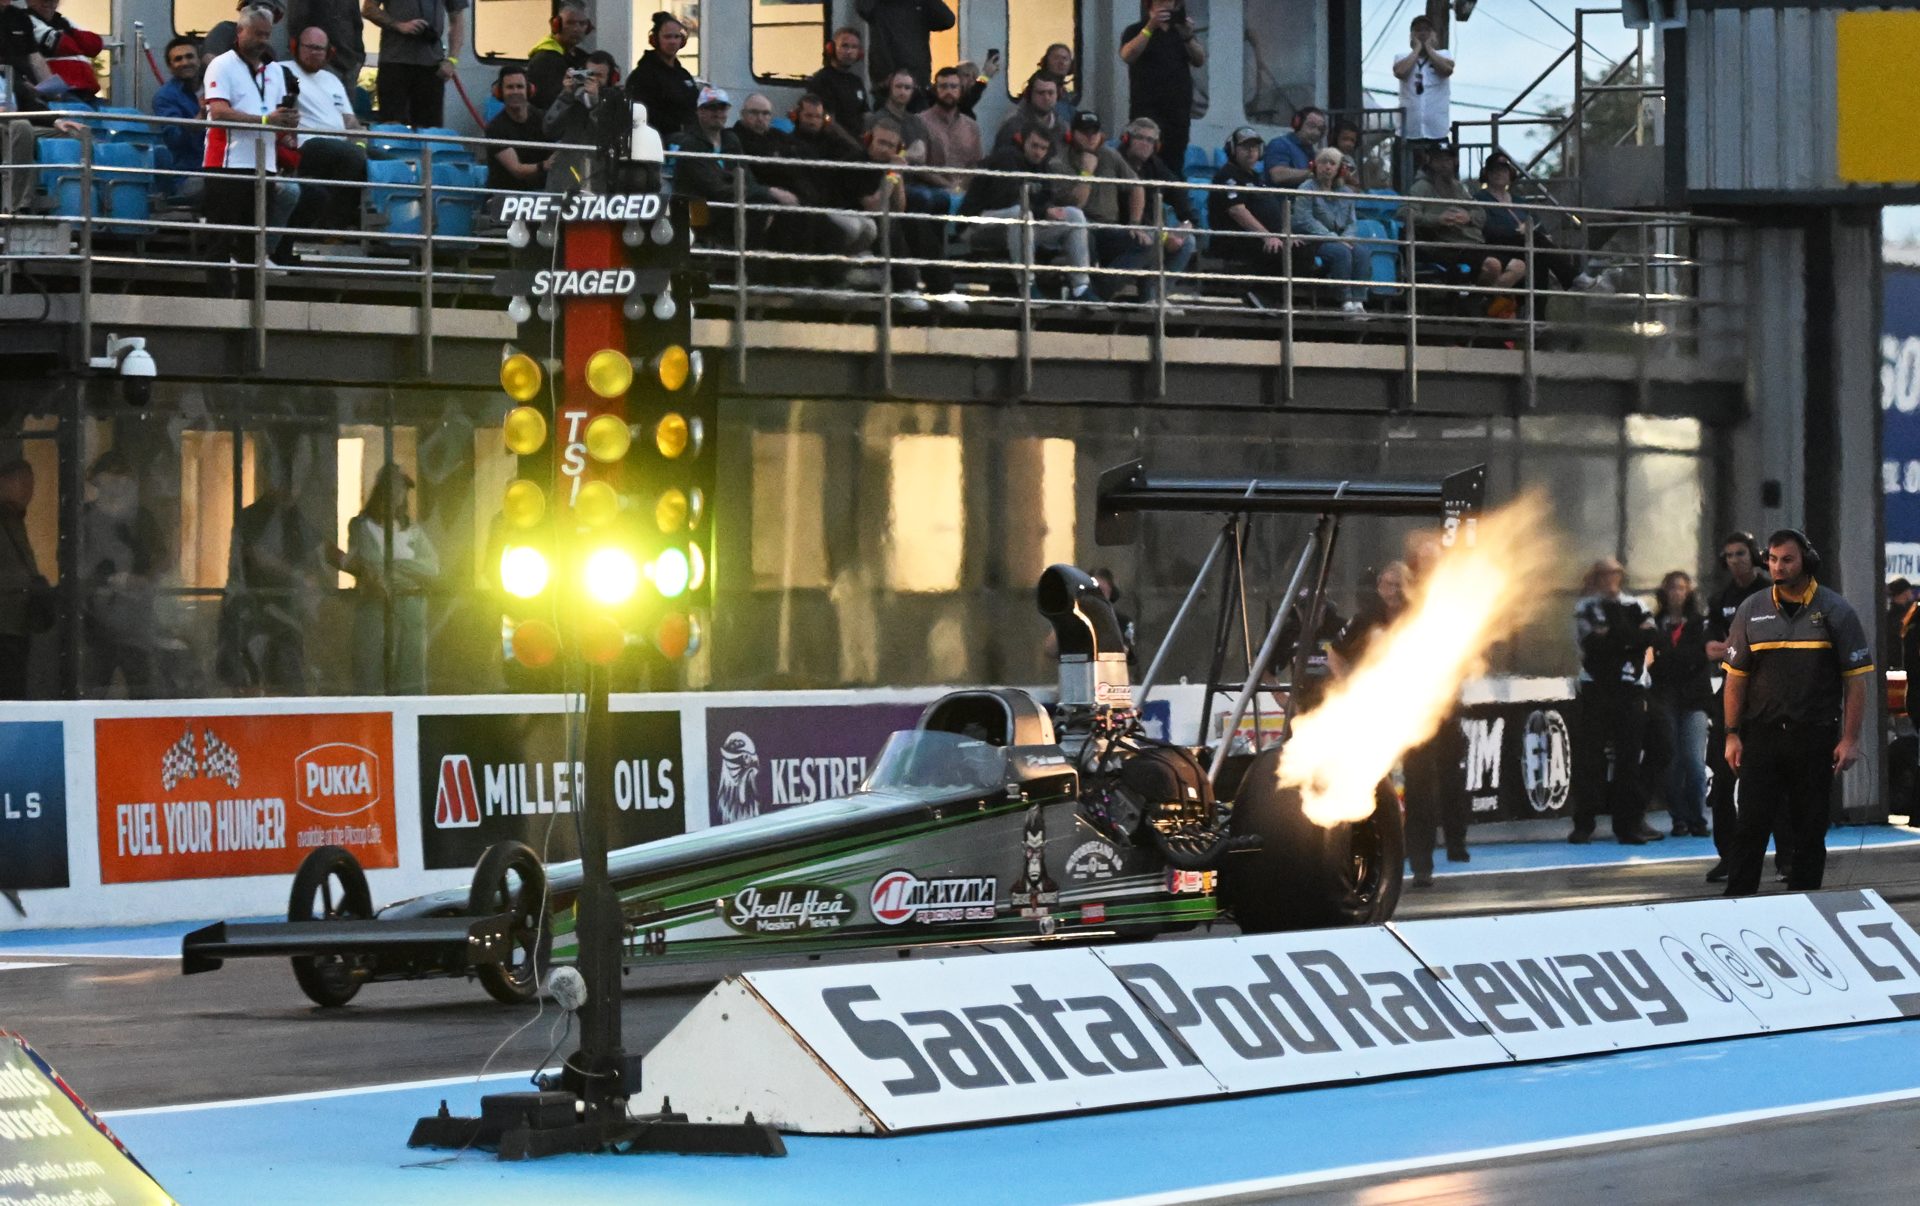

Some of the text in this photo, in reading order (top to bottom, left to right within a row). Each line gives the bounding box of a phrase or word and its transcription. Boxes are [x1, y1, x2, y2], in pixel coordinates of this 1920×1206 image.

[500, 194, 660, 221] PRE-STAGED
[531, 270, 636, 295] STAGED
[305, 761, 372, 798] PUKKA
[483, 757, 676, 817] MILLER OILS
[116, 797, 286, 857] FUEL YOUR HUNGER
[965, 906, 994, 920] OILS
[821, 947, 1690, 1097] Santa Pod Raceway
